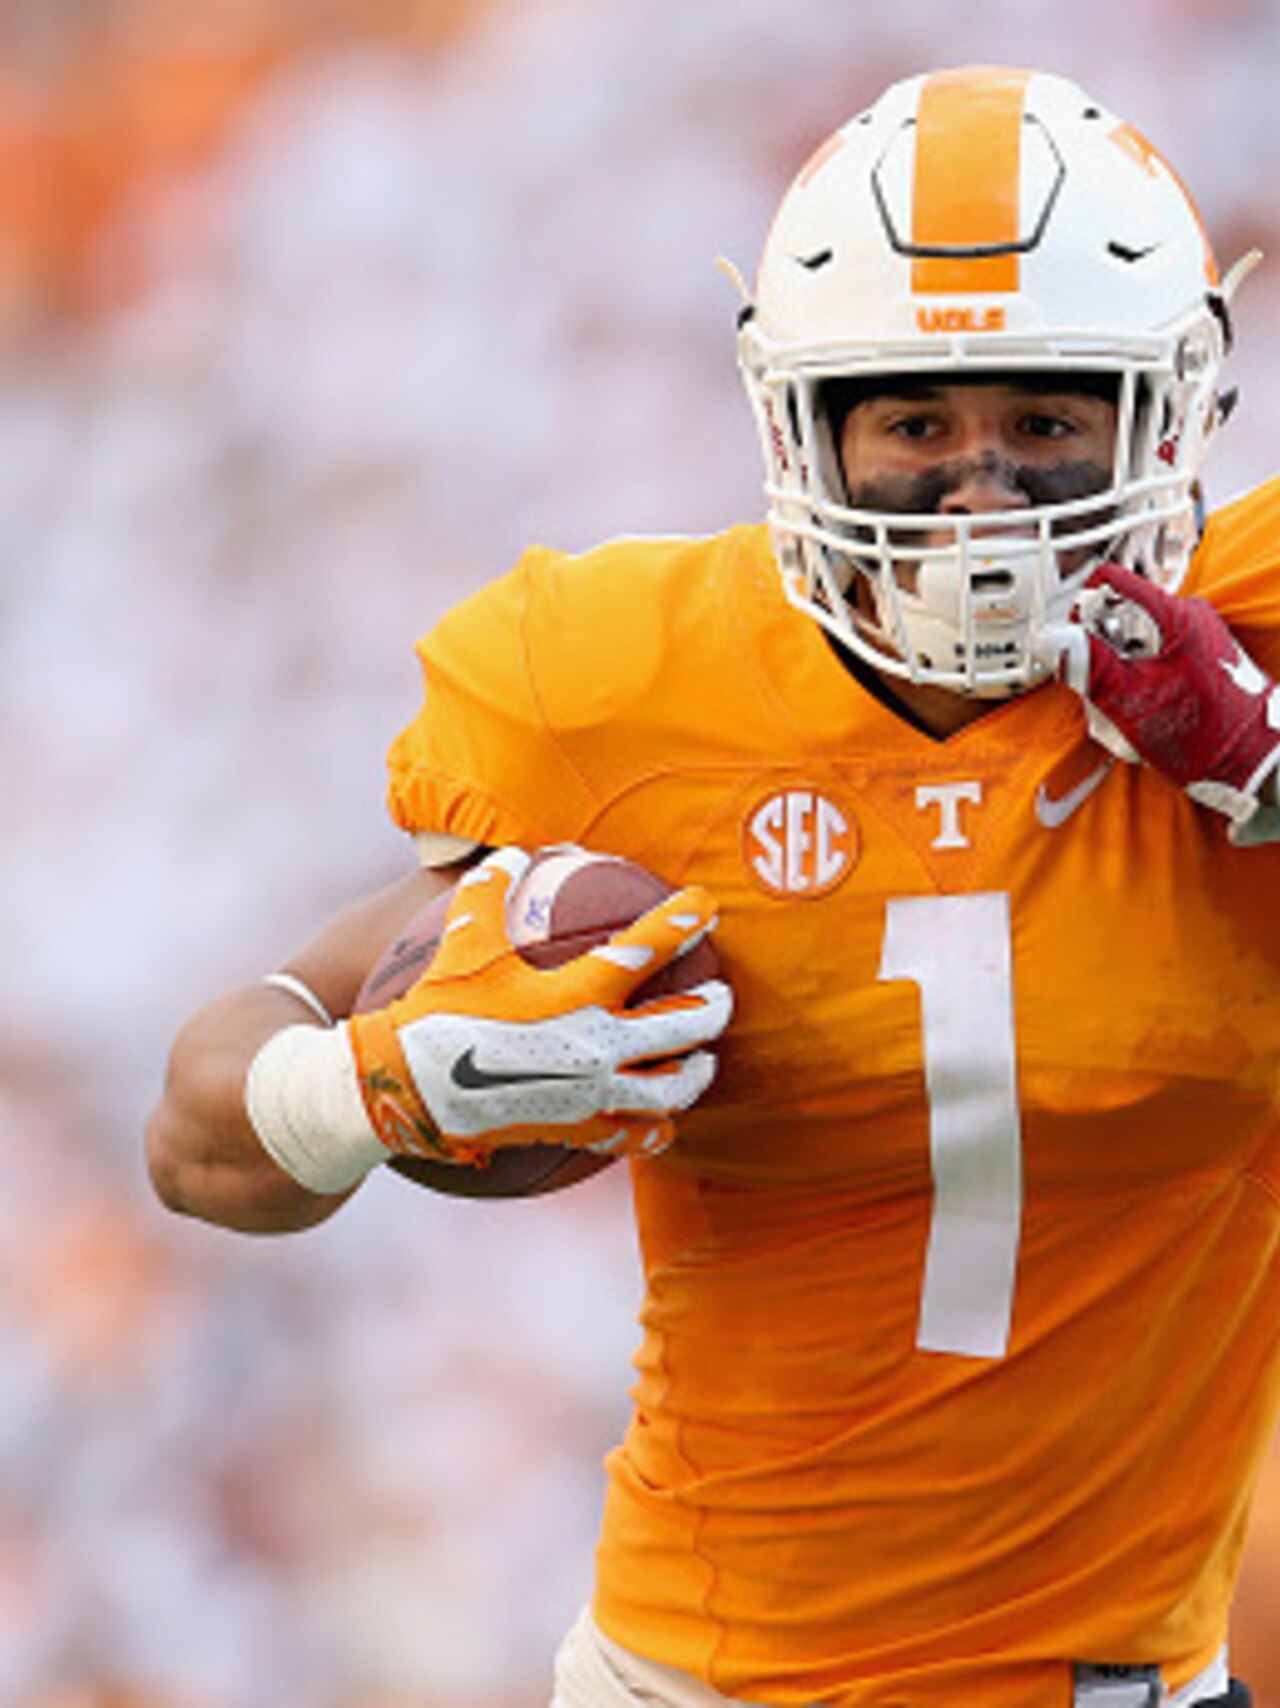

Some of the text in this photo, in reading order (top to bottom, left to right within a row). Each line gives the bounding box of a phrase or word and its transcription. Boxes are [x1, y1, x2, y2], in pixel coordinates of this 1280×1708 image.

[750, 791, 848, 892] SEC
[916, 782, 982, 848] T
[877, 891, 1022, 1357] 1
